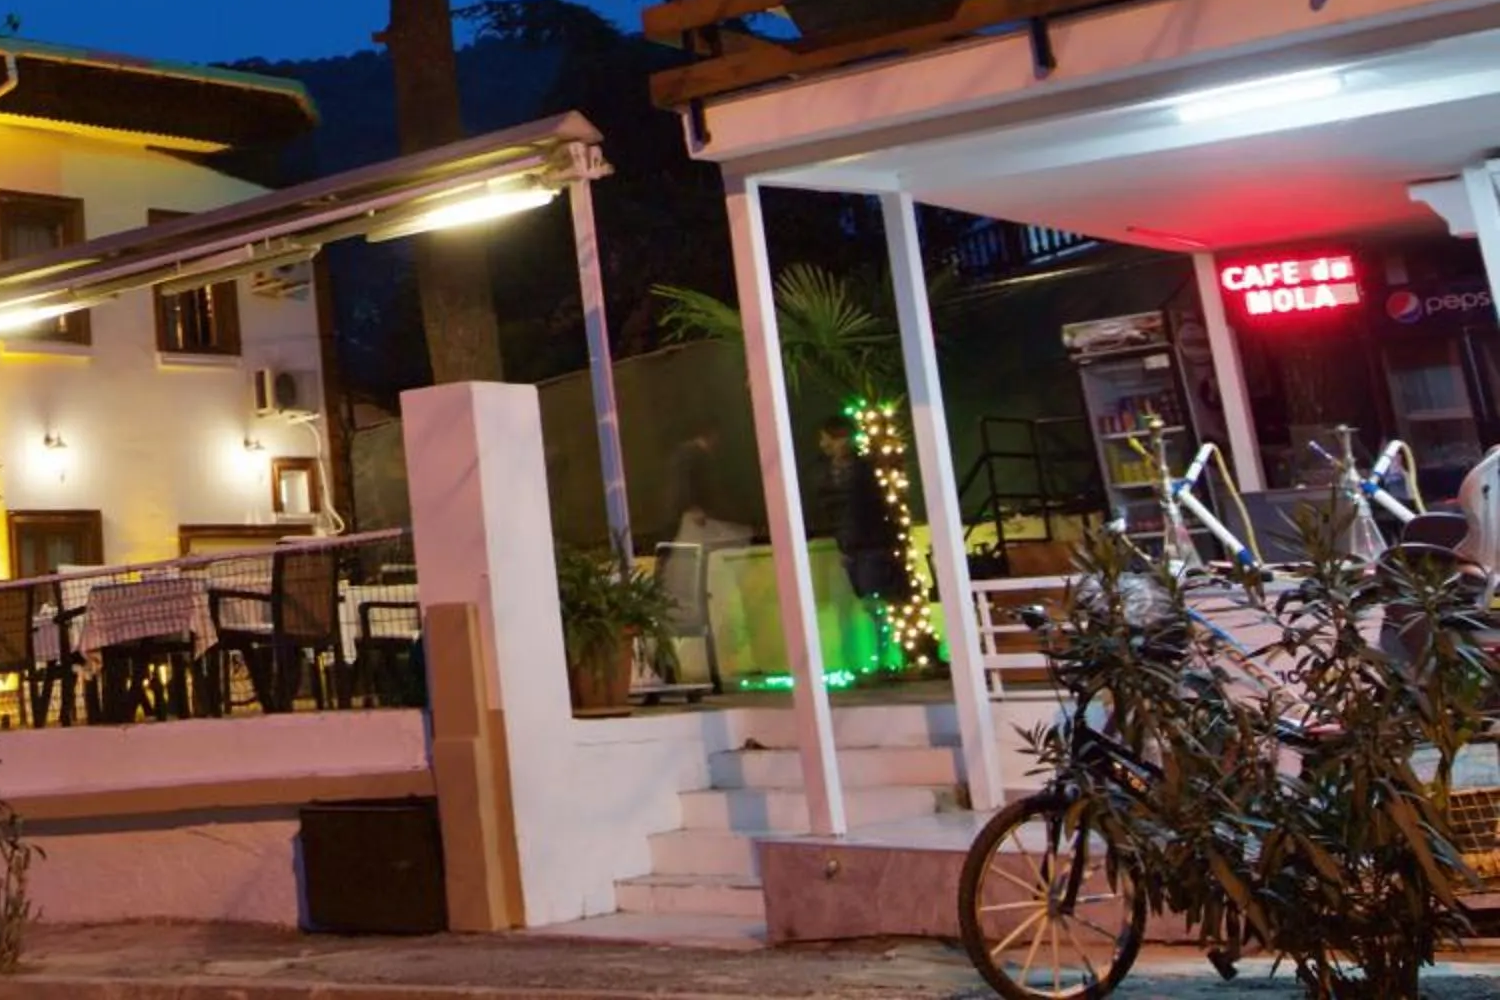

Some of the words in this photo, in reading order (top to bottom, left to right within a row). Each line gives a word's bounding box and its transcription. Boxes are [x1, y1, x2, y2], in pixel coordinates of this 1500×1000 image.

[1221, 260, 1301, 291] CAFE
[1246, 283, 1337, 315] MOLA
[1425, 291, 1491, 316] peps
